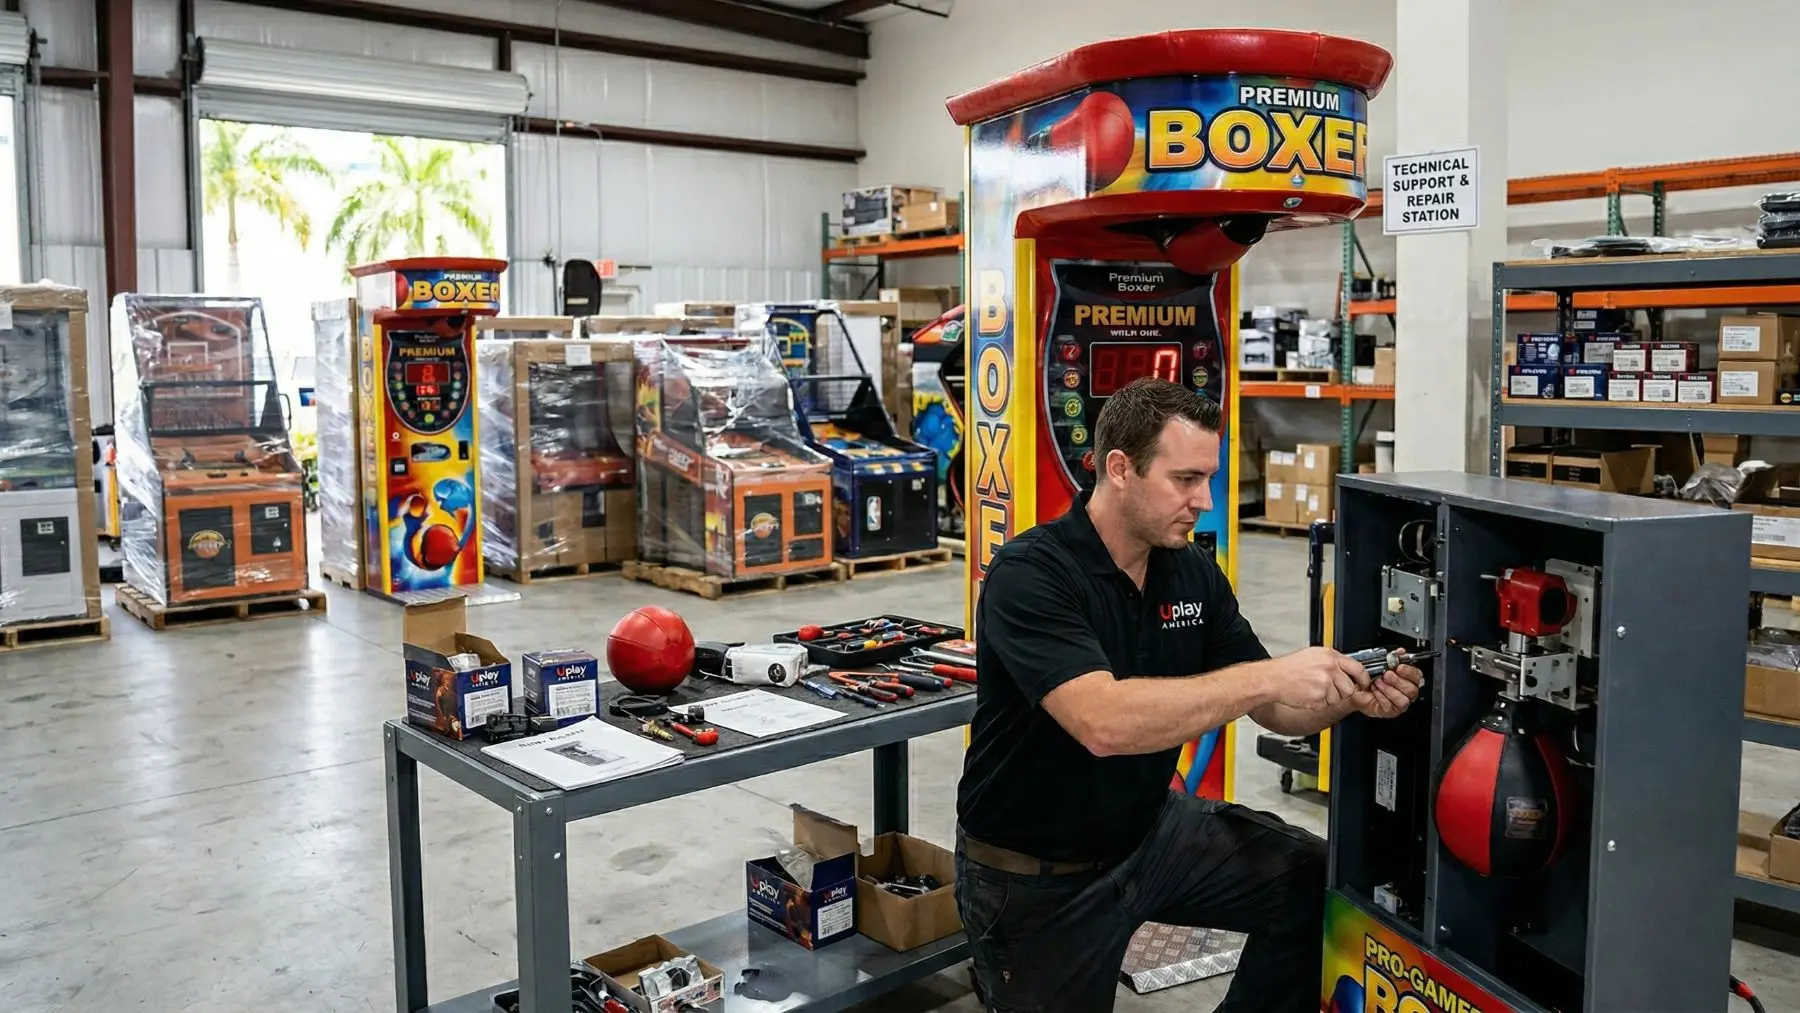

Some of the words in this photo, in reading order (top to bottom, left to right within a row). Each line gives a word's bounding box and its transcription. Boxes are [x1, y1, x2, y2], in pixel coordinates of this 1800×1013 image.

[1240, 86, 1340, 112] PREMIUM
[1393, 158, 1469, 176] TECHNICAL
[1393, 175, 1455, 192] SUPPORT
[1460, 174, 1469, 186] &
[1407, 192, 1455, 207] REPAIR
[1402, 208, 1459, 223] STATION
[1109, 272, 1164, 282] Premium
[1118, 283, 1156, 292] Boxer
[1074, 305, 1196, 326] PREMIUM
[399, 347, 456, 357] PREMIUM
[1160, 601, 1203, 620] Uplay
[556, 665, 586, 677] Uplay
